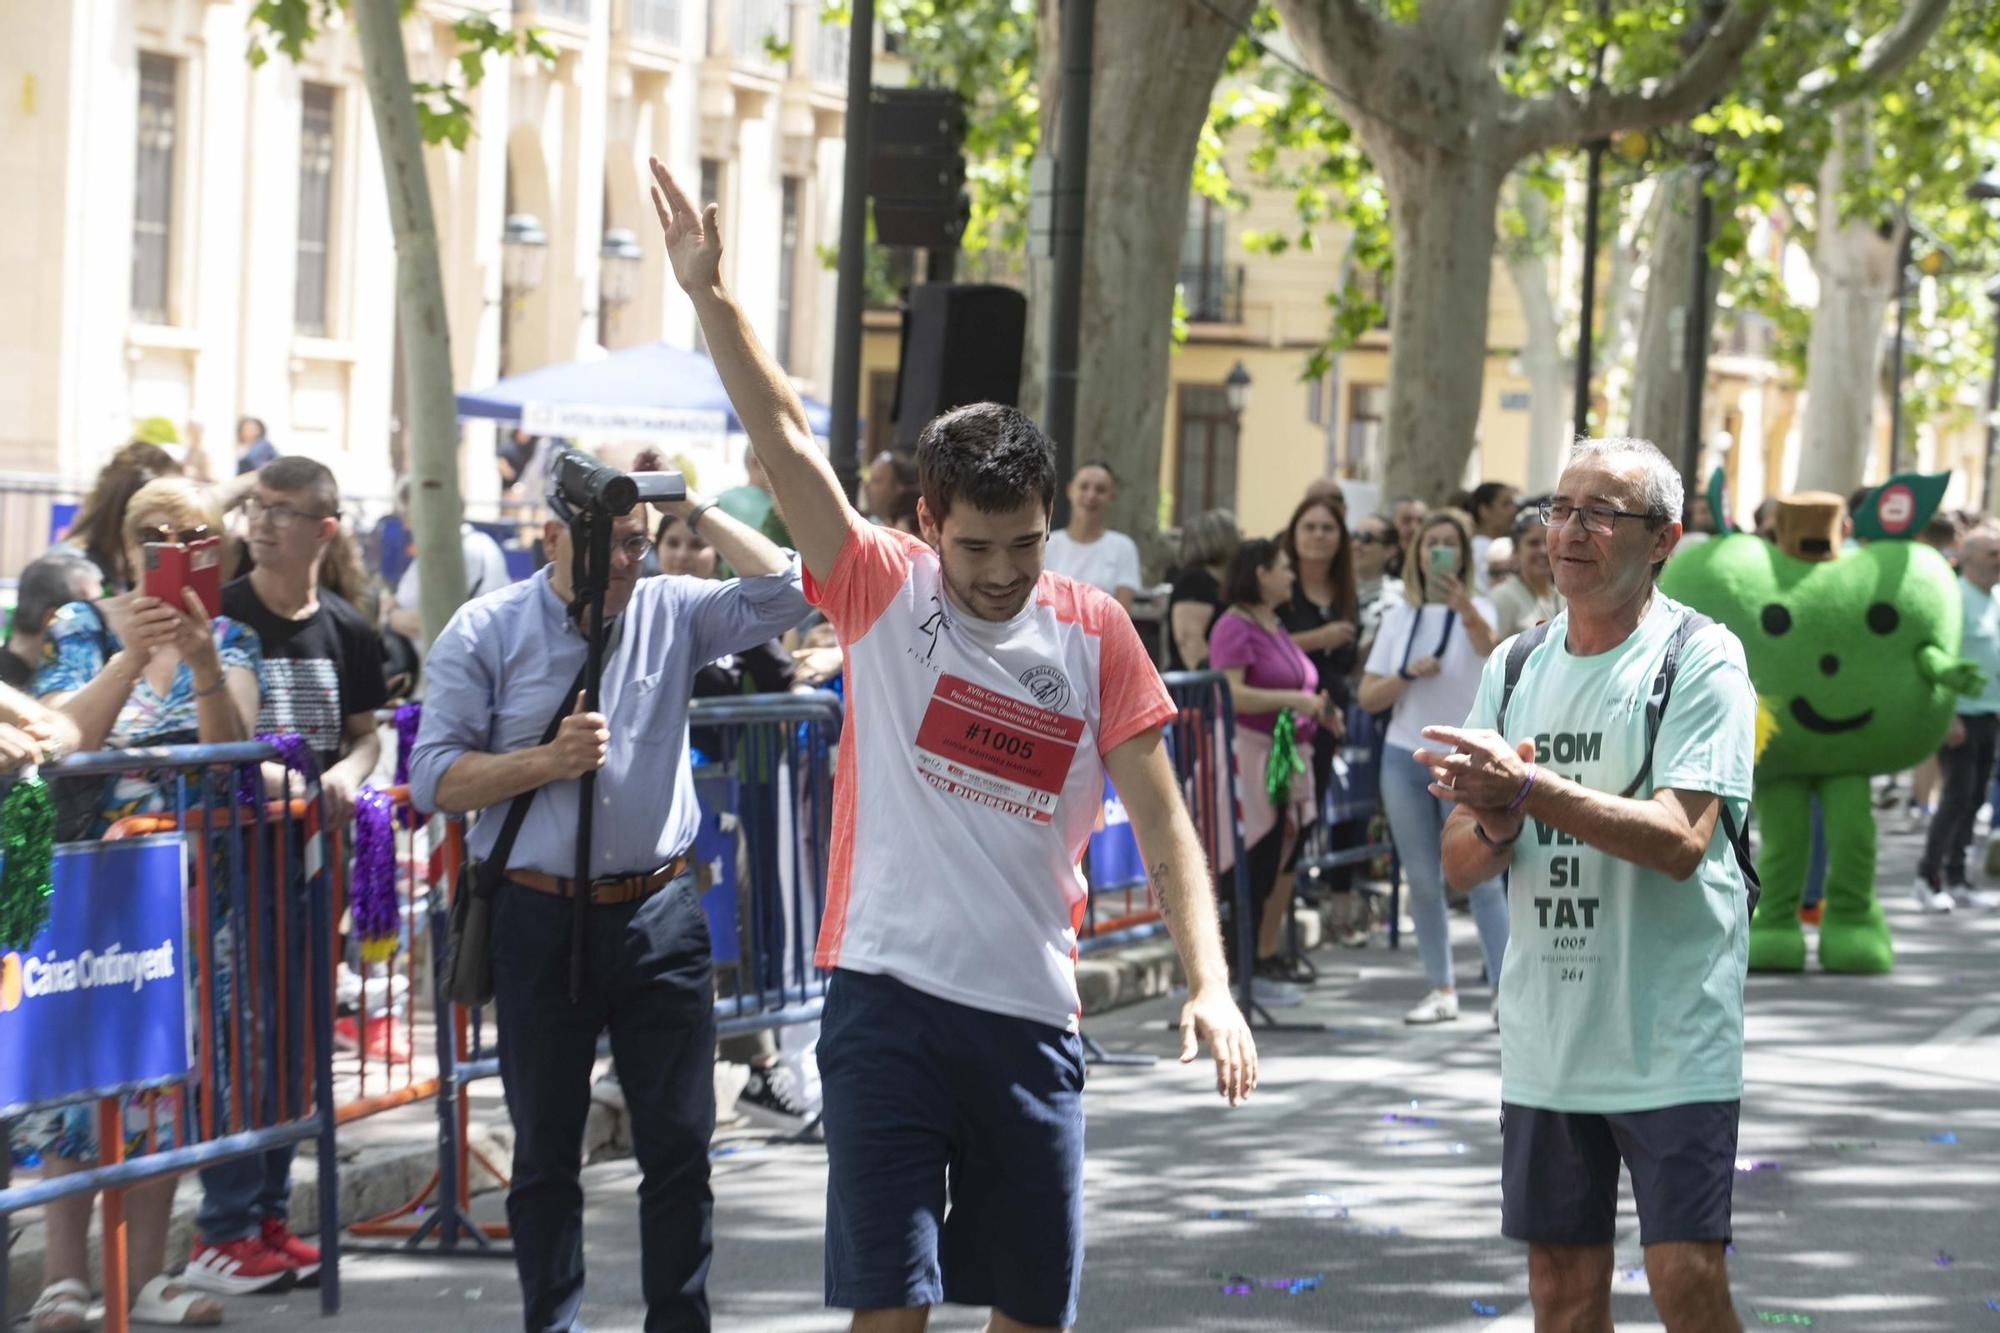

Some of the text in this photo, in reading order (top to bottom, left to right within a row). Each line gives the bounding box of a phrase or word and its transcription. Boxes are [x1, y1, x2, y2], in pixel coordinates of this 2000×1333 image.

[950, 689, 1068, 737] Persones amb Diversitat Funcional
[985, 690, 1012, 709] Carrera
[1012, 698, 1040, 718] Popular
[1040, 709, 1052, 723] per
[965, 721, 1036, 760] #1005
[1534, 732, 1602, 763] SOM
[1549, 856, 1580, 888] SI
[1534, 898, 1599, 928] TAT
[1553, 936, 1587, 950] 1005
[23, 938, 175, 998] Caixa Ontinyent
[1560, 967, 1584, 982] 261
